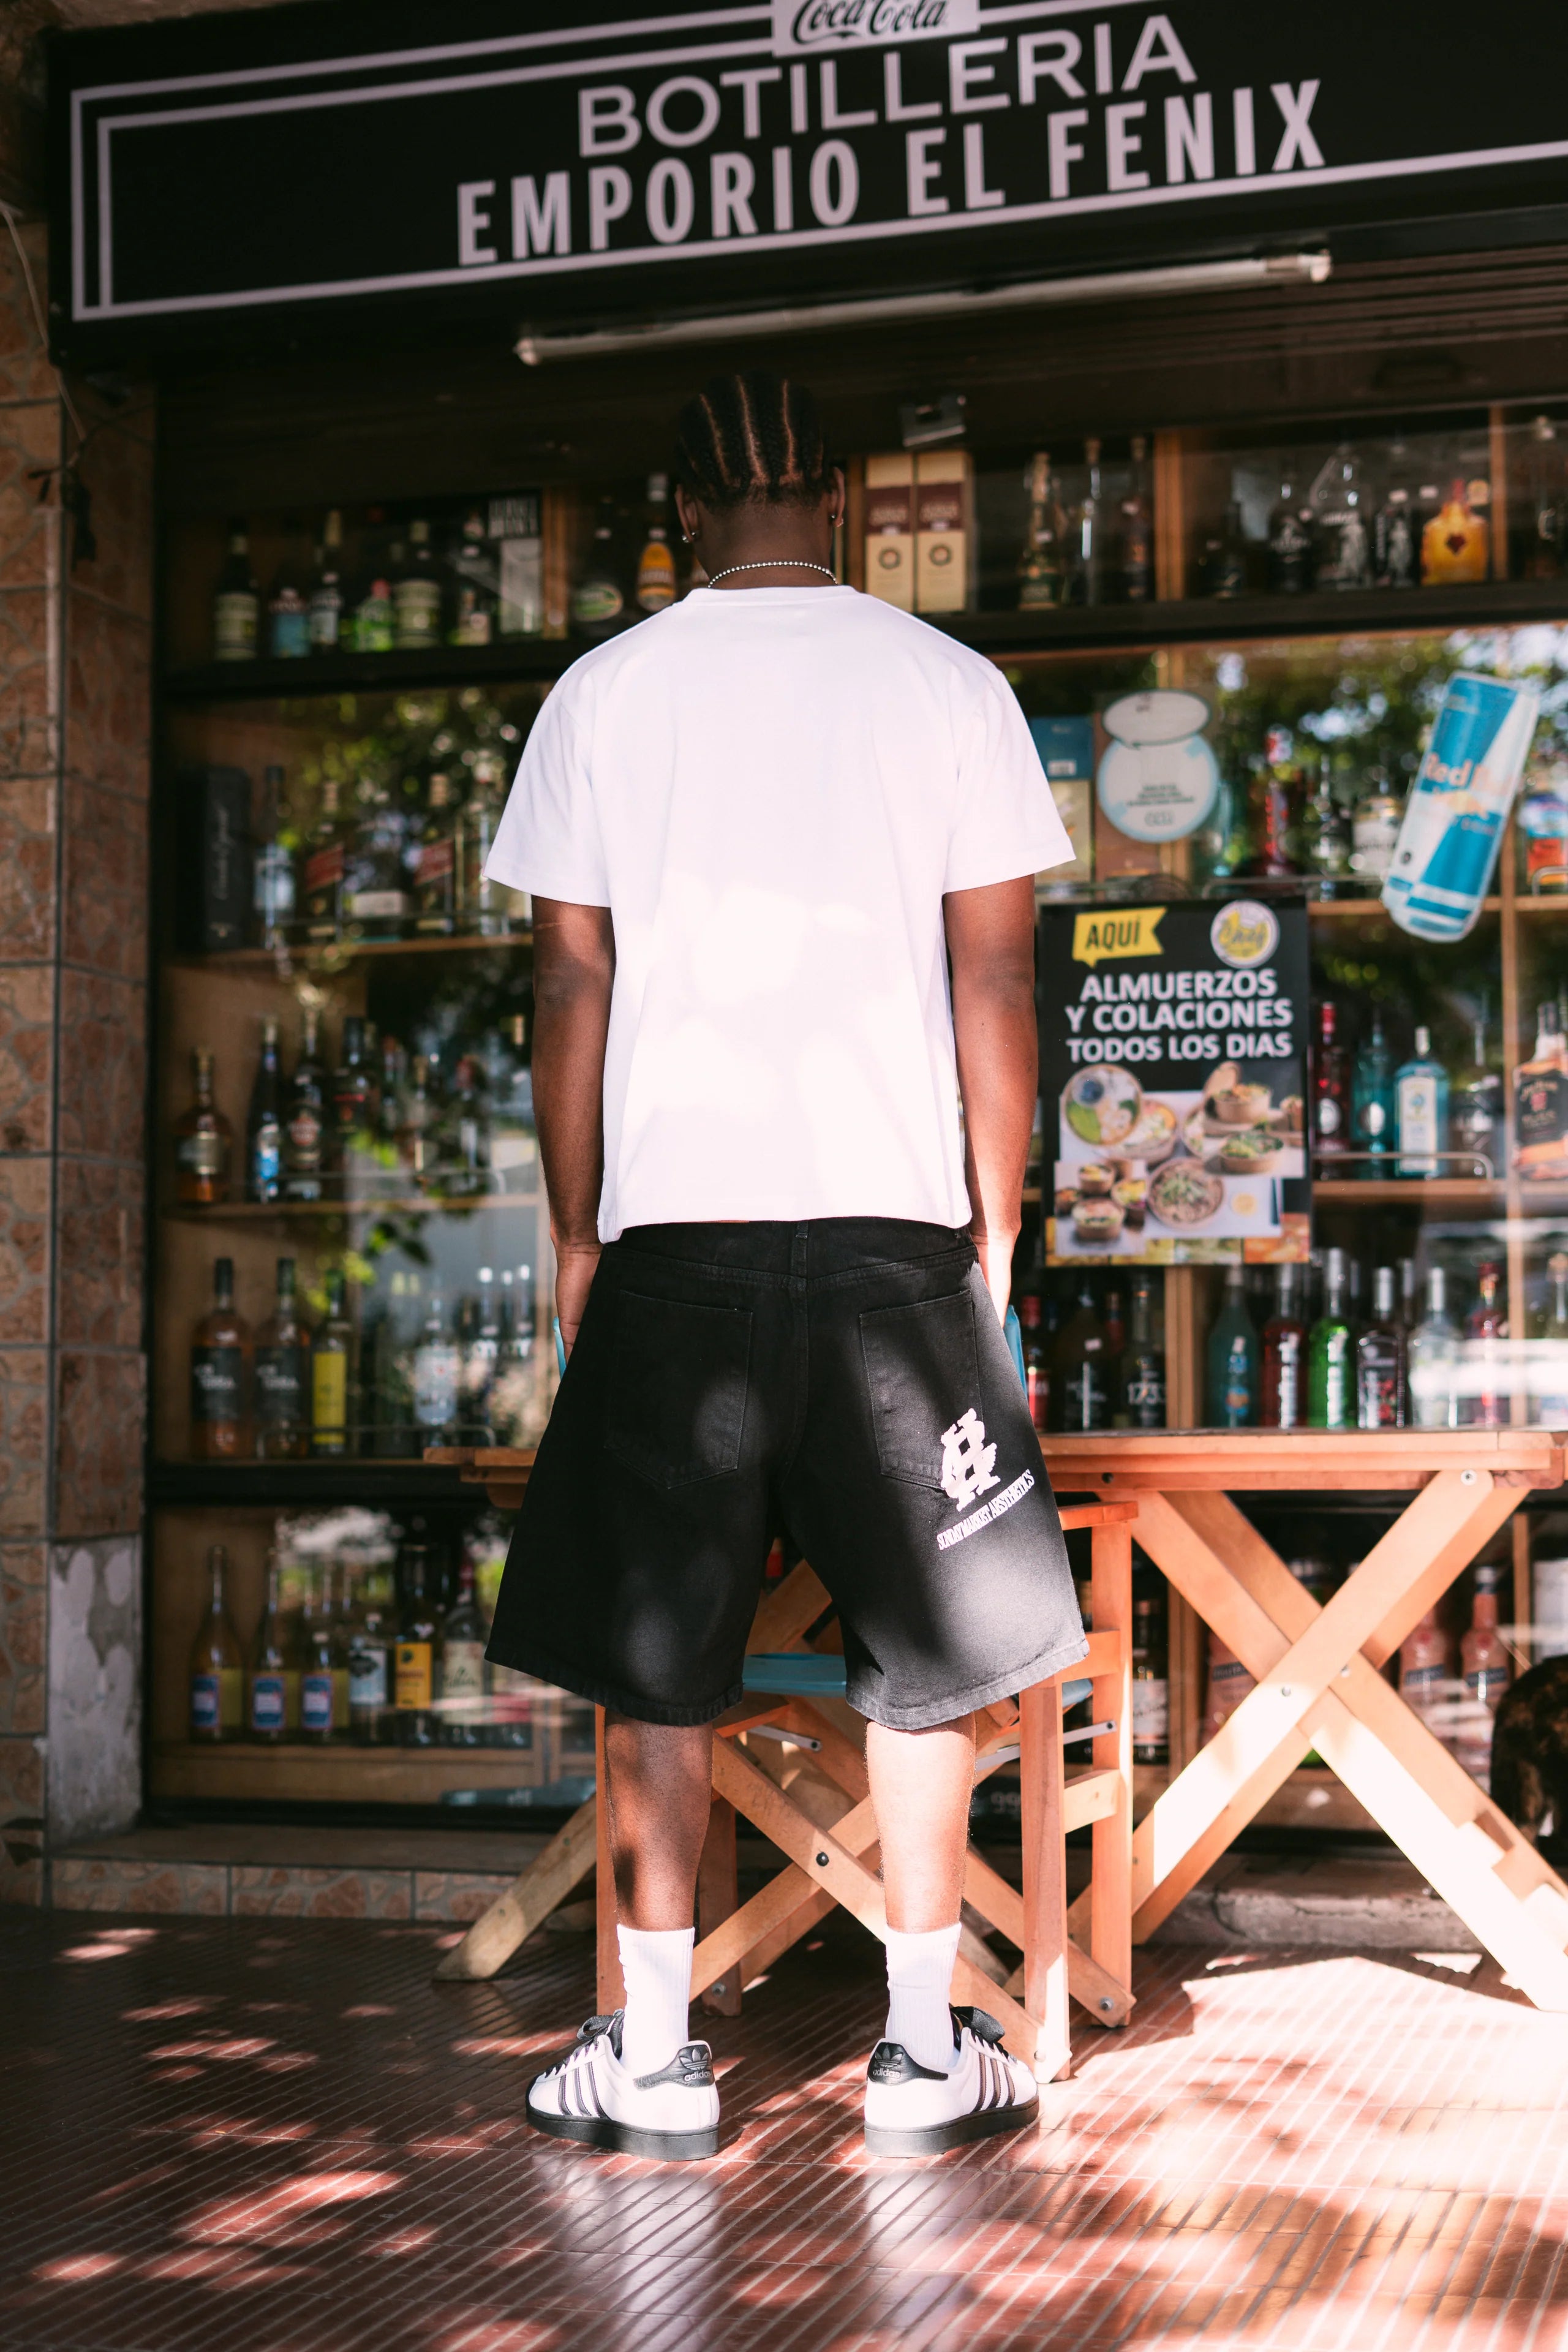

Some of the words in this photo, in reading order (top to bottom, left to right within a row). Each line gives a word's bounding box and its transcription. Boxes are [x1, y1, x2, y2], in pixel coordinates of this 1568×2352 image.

[578, 13, 1198, 157] BOTILLERIA
[458, 140, 859, 266] EMPORIO
[905, 123, 1006, 217] EL
[1046, 78, 1325, 200] FENIX
[1079, 967, 1278, 1003] ALMUERZOS
[1065, 1005, 1087, 1033] Y
[1092, 998, 1294, 1033] COLACIONES
[1066, 1035, 1164, 1063] TODOS
[1167, 1033, 1221, 1061] LOS
[1225, 1031, 1294, 1060] DIAS
[937, 1521, 965, 1550] SUNDAY
[960, 1504, 993, 1537] MARKET
[684, 2070, 711, 2082] adidas
[872, 2068, 901, 2078] adidas
